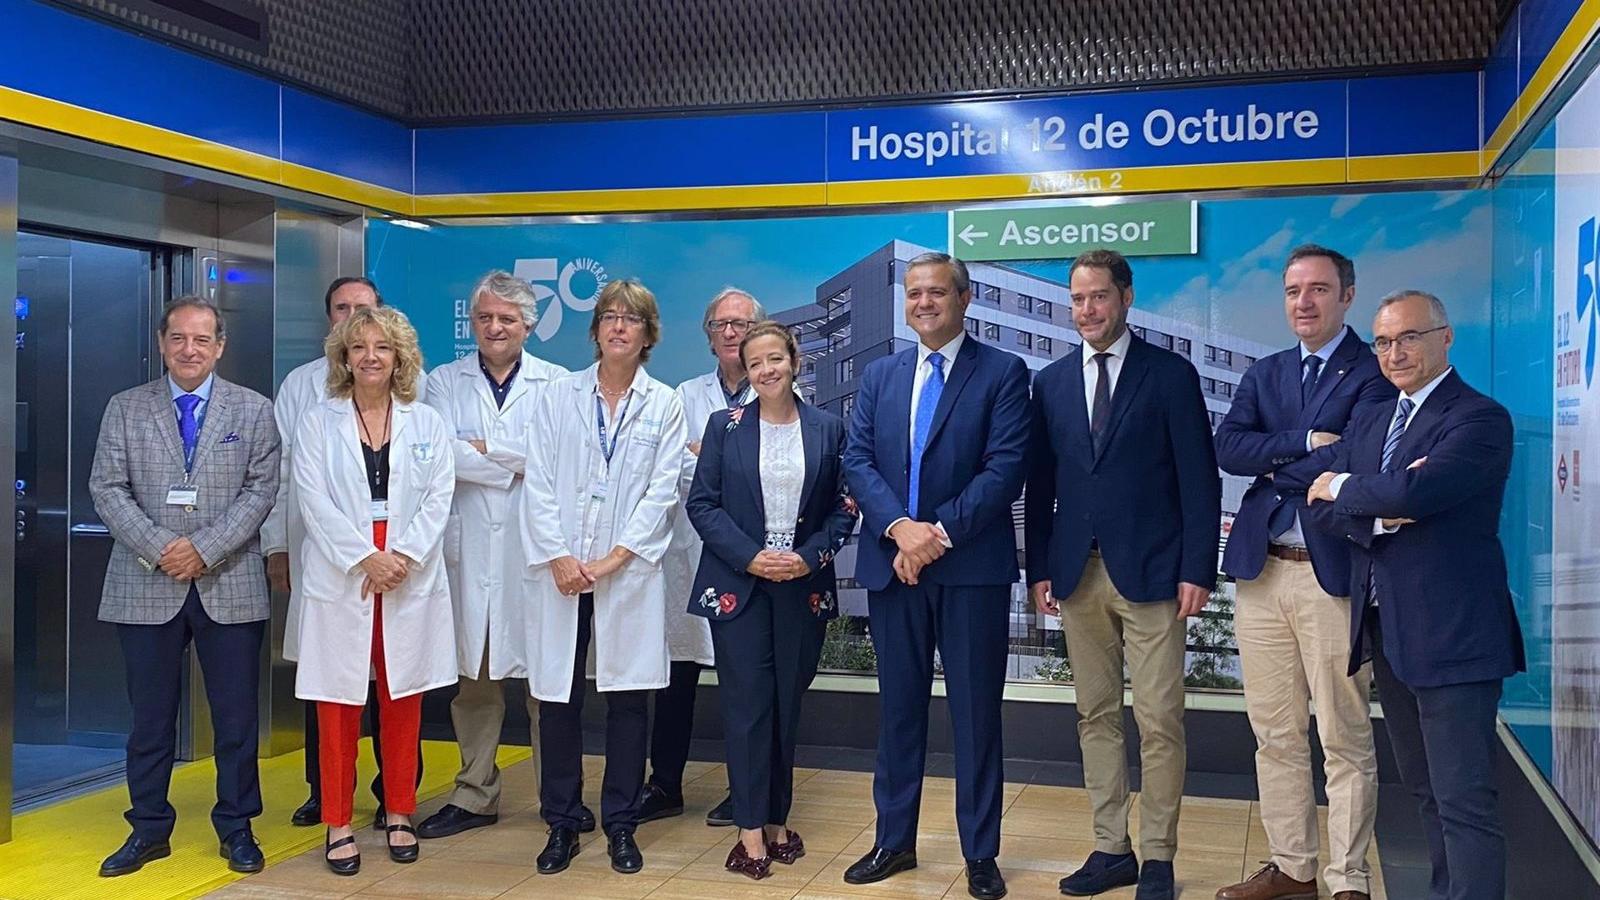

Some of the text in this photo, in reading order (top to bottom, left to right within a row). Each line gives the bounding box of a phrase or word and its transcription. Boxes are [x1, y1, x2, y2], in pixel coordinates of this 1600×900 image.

[851, 104, 1320, 166] Hospital 12 de Octubre
[1027, 171, 1123, 193] Andén 2
[999, 218, 1156, 246] Ascensor
[454, 320, 470, 340] EN
